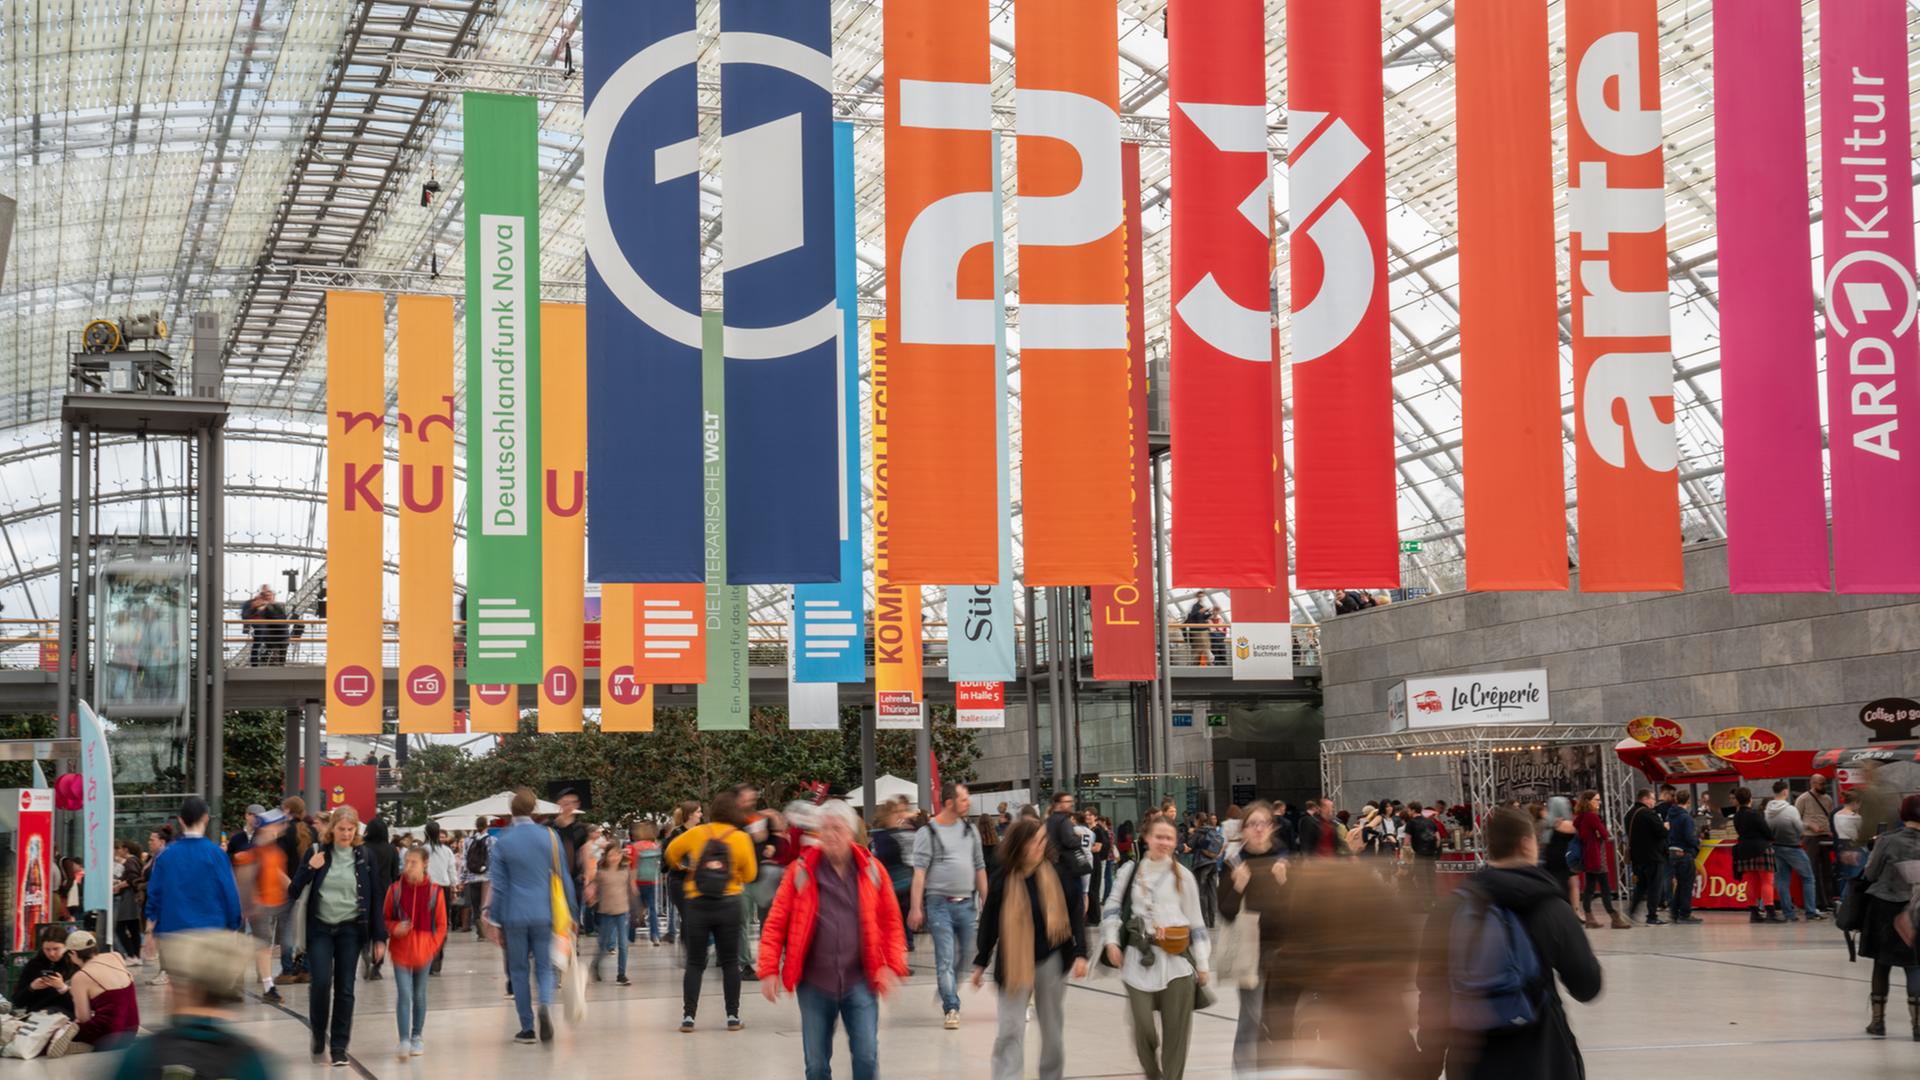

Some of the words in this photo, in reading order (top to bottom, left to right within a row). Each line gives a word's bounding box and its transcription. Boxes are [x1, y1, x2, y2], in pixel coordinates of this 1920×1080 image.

[1840, 66, 1889, 239] Kultur
[492, 223, 514, 291] Nova
[1568, 31, 1678, 472] arte
[1849, 337, 1900, 461] ARD
[491, 299, 516, 527] Deutschlandfunk
[704, 467, 721, 597] LITERARISCHE
[705, 600, 722, 631] DIE
[730, 603, 741, 625] das
[730, 627, 741, 645] für
[730, 648, 742, 693] Journal
[731, 695, 742, 713] Ein
[960, 691, 969, 700] in
[970, 691, 993, 701] Halle
[880, 704, 919, 715] Thüringen
[1864, 707, 1895, 722] Coffee
[1896, 710, 1907, 721] to
[1657, 726, 1680, 739] Dog
[1714, 736, 1737, 749] Hot
[1750, 739, 1776, 754] Dog
[1708, 876, 1748, 902] Dog
